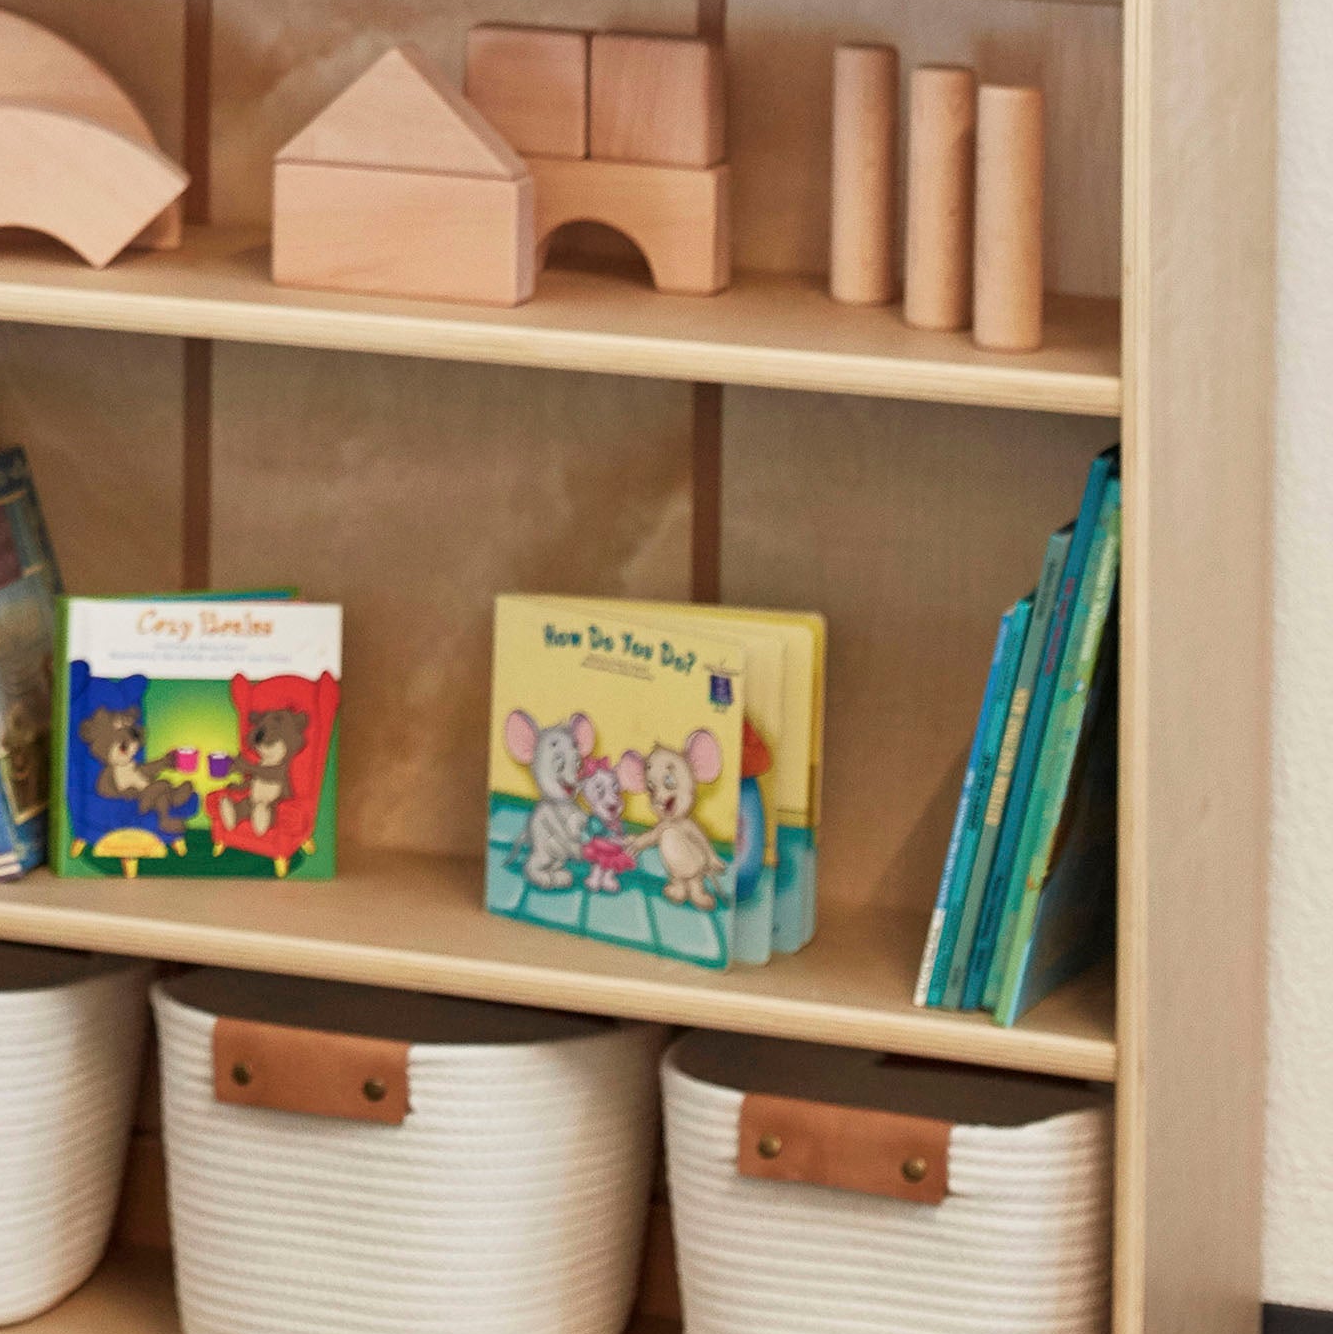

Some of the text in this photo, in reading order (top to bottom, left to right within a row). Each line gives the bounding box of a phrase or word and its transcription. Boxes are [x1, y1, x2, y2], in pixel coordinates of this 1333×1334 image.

[136, 608, 193, 640] Cozy
[543, 623, 581, 648] How
[588, 623, 614, 651] Do
[622, 632, 653, 660] You
[660, 640, 697, 674] Do?
